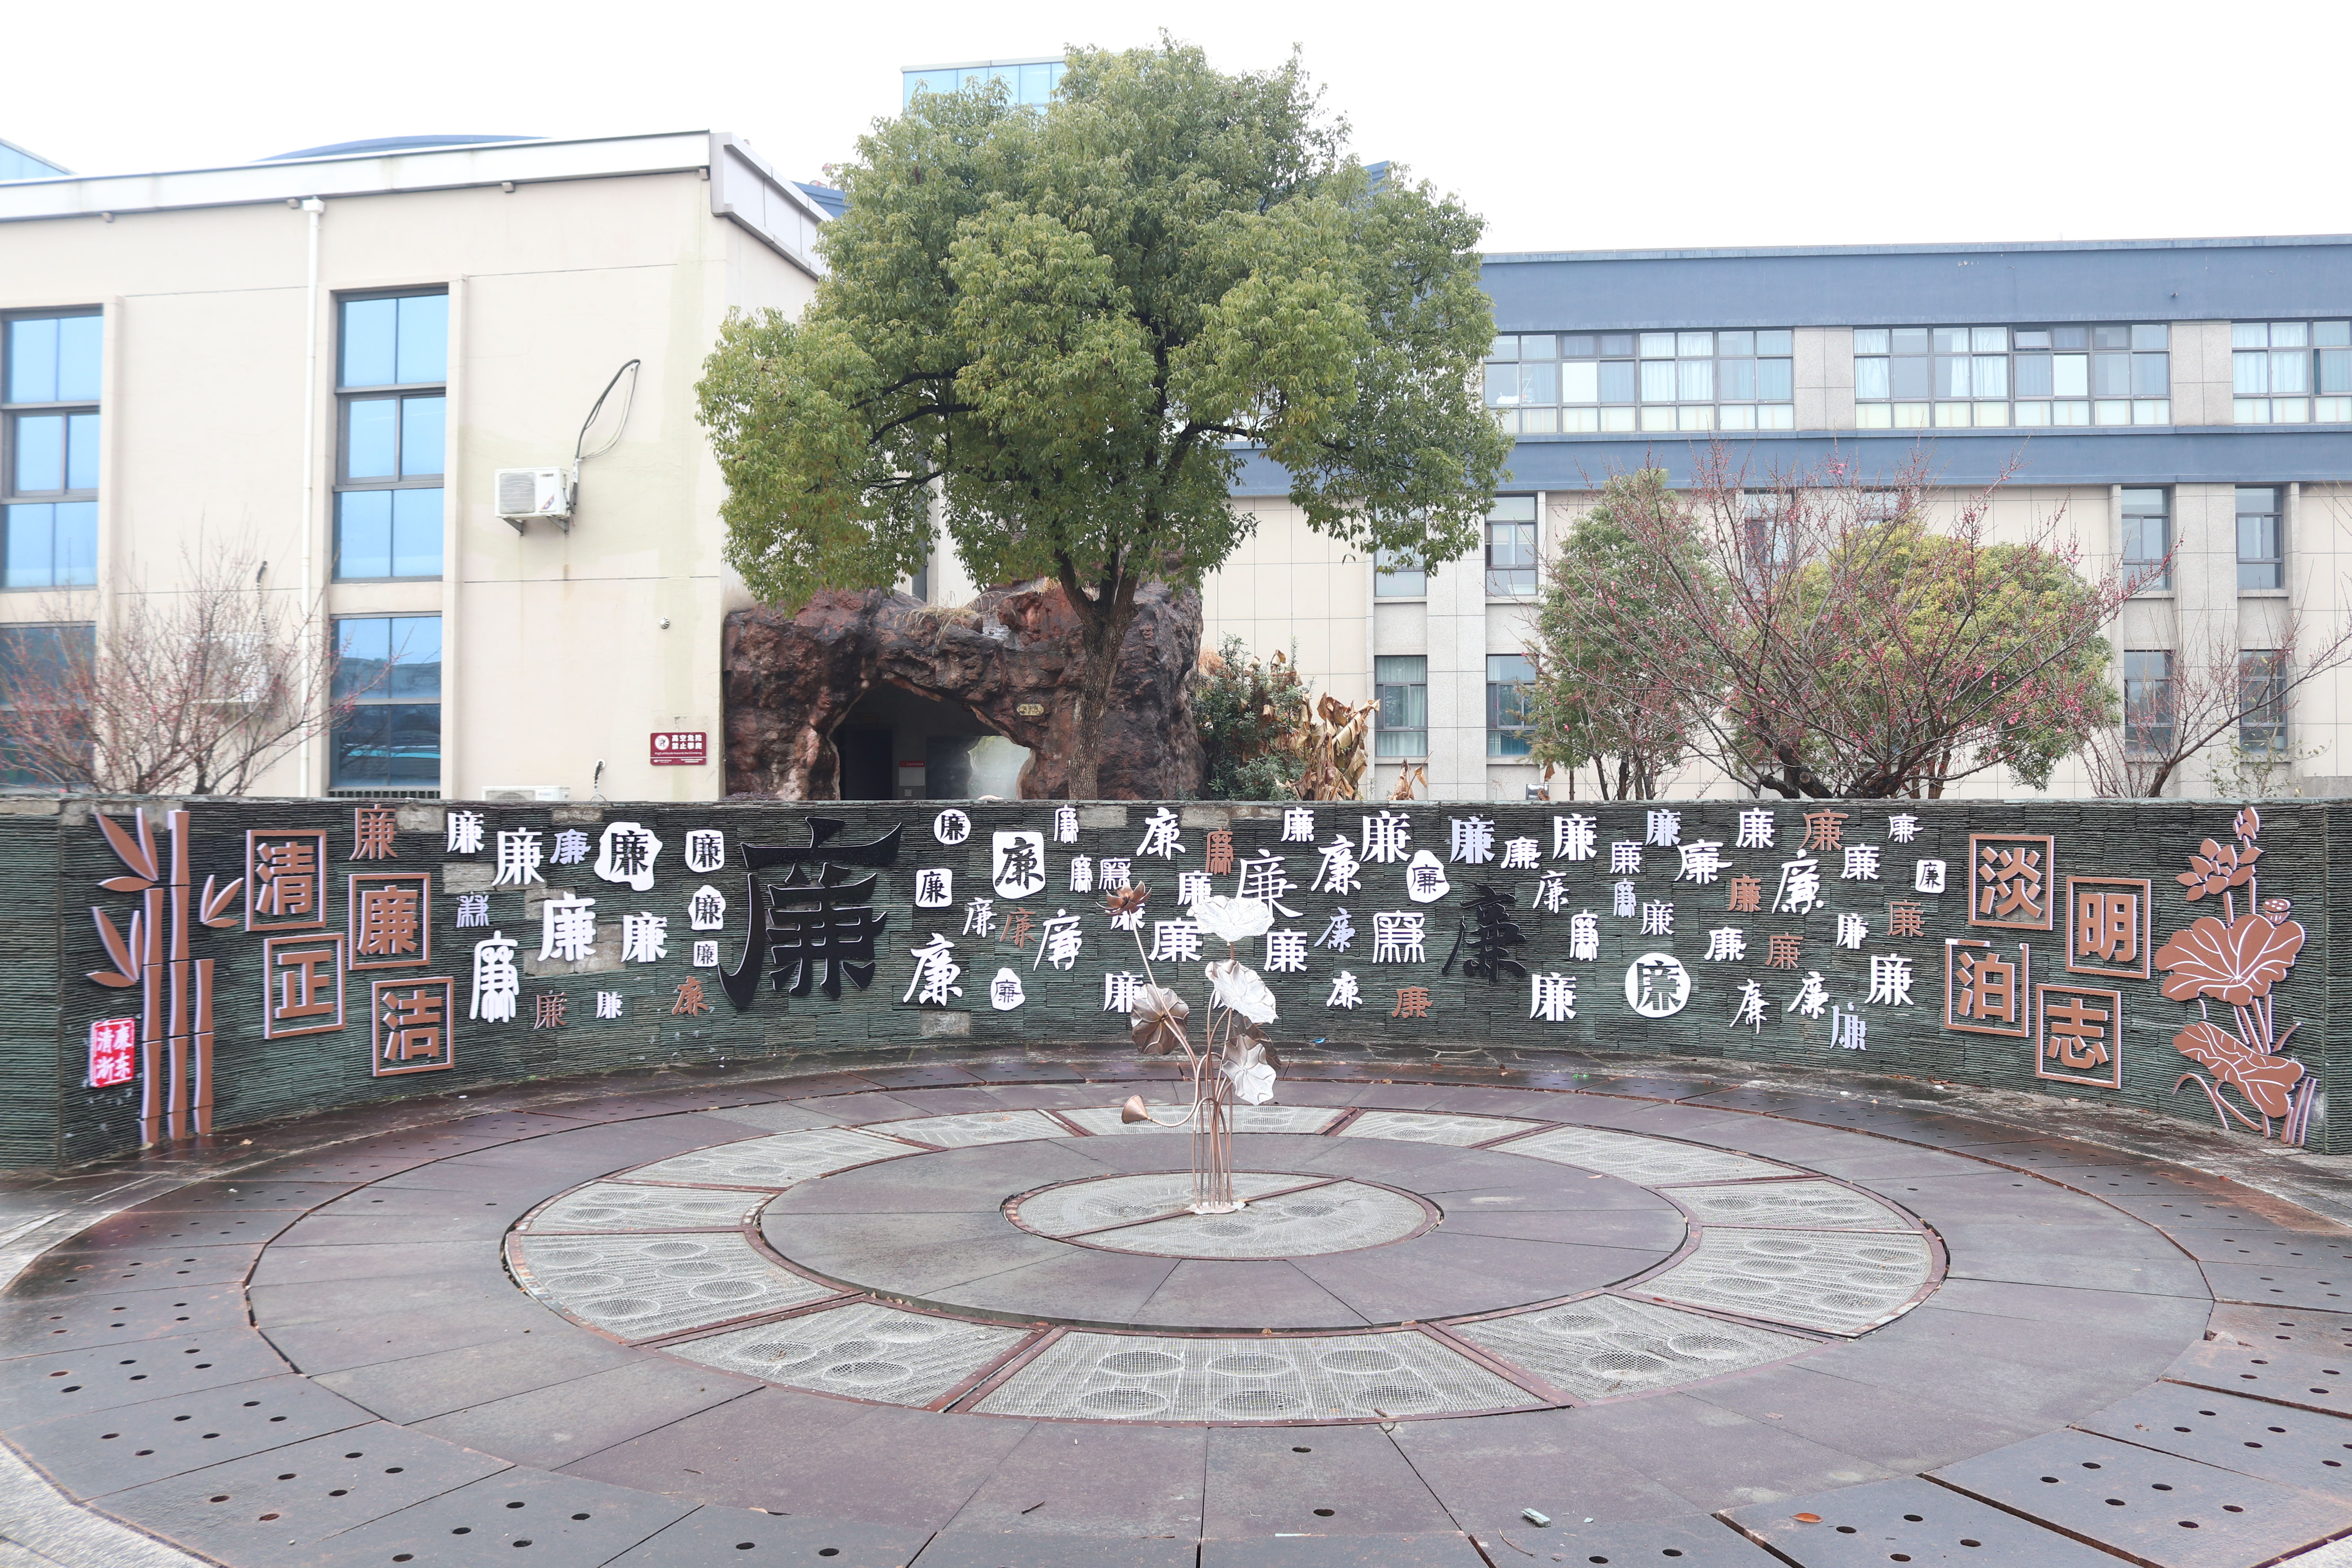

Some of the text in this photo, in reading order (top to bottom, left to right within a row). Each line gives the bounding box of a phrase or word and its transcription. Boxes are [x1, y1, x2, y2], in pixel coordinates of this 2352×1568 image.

[349, 804, 398, 860] 廉
[447, 811, 485, 853] 廉
[940, 813, 965, 840] 廉
[1137, 807, 1186, 860] 廉
[1281, 807, 1314, 842] 廉
[1359, 810, 1411, 862] 廉
[1450, 817, 1495, 863] 廉
[1553, 813, 1597, 860] 廉
[1645, 809, 1681, 846] 廉
[1736, 808, 1775, 848] 廉
[1798, 808, 1849, 851] 廉
[1888, 813, 1924, 843] 廉
[491, 827, 544, 886] 廉
[550, 829, 591, 864] 廉
[610, 830, 651, 875] 廉
[693, 834, 721, 867] 廉
[995, 837, 1044, 889] 廉
[1310, 834, 1361, 896] 廉
[1501, 836, 1541, 869] 廉
[1610, 839, 1643, 874] 廉
[1675, 839, 1733, 884] 廉
[1840, 843, 1880, 880] 廉
[920, 871, 947, 904] 廉
[1178, 870, 1212, 905] 廉
[1236, 849, 1303, 918] 廉
[1408, 864, 1446, 894] 廉
[1533, 870, 1569, 914] 廉
[1728, 875, 1762, 913] 廉
[1772, 849, 1824, 915] 廉
[1919, 862, 1941, 889] 廉
[537, 891, 596, 962] 廉
[694, 895, 721, 924] 廉
[718, 817, 902, 1008] 廉
[962, 897, 997, 937] 廉
[1000, 907, 1036, 948] 廉
[1314, 907, 1356, 953] 廉
[1640, 900, 1675, 935] 廉
[1887, 900, 1925, 936] 廉
[621, 911, 668, 962] 廉
[1033, 909, 1082, 971] 廉
[1148, 917, 1203, 962] 廉
[1263, 928, 1308, 972] 廉
[1442, 883, 1526, 980] 廉
[1704, 926, 1747, 961] 廉
[1765, 933, 1803, 969] 廉
[1836, 913, 1869, 949] 廉
[696, 944, 715, 964] 廉
[903, 933, 963, 1006] 廉
[672, 976, 708, 1016] 廉
[991, 979, 1021, 1003] 廉
[1103, 971, 1143, 1013] 廉
[1327, 971, 1363, 1010] 廉
[1530, 972, 1577, 1021] 廉
[1636, 960, 1682, 1010] 廉
[1788, 971, 1829, 1019] 廉
[1865, 954, 1914, 1006] 廉
[534, 992, 567, 1029] 廉
[596, 991, 622, 1018] 廉
[1392, 986, 1433, 1018] 廉
[1730, 979, 1770, 1034] 廉
